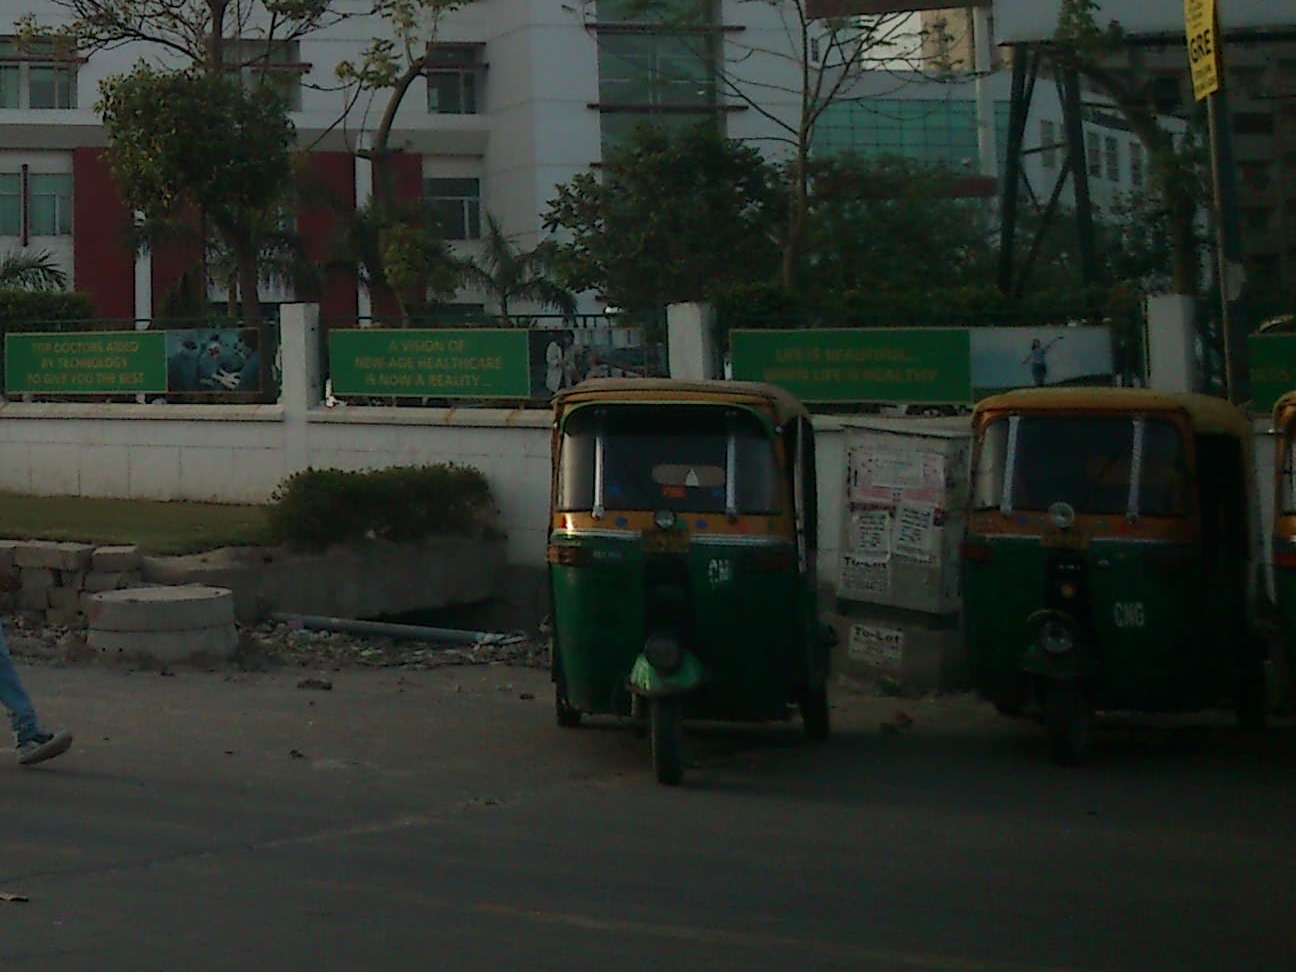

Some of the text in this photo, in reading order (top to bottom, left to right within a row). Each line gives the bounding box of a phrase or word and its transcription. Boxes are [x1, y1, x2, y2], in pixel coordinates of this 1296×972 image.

[1190, 29, 1212, 64] GRE
[388, 339, 466, 352] A VISION OF
[417, 355, 504, 370] HEALTHCARE
[378, 374, 412, 387] NOW
[415, 374, 426, 387] A
[1113, 601, 1146, 628] CNG
